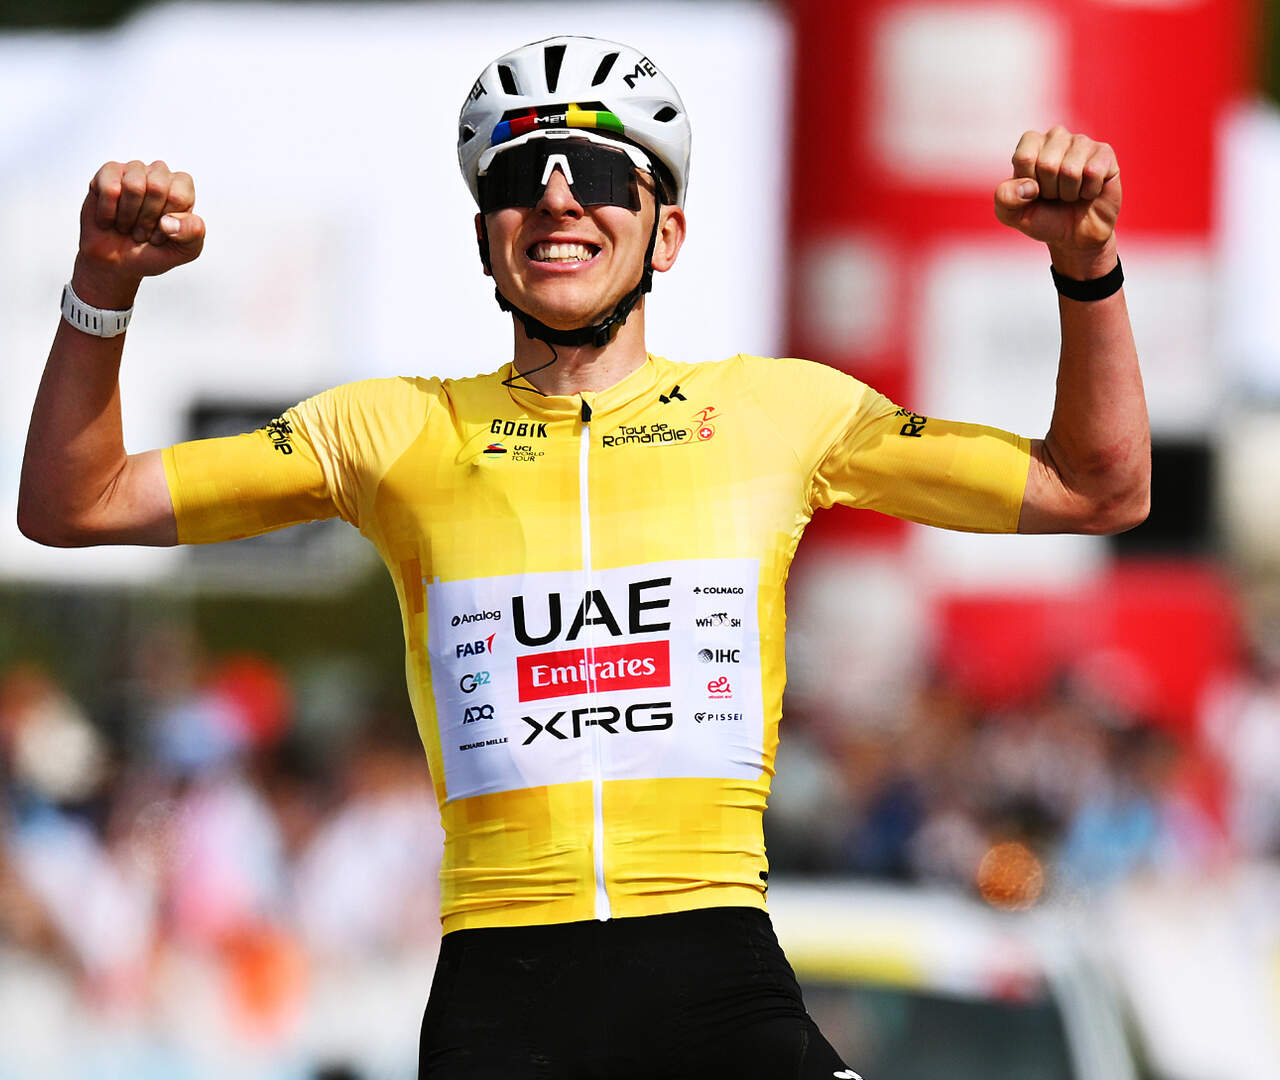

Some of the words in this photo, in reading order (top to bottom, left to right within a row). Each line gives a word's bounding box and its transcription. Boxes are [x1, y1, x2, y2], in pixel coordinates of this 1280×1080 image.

[490, 419, 549, 438] GOBIK
[619, 425, 647, 435] Tour
[650, 423, 668, 433] de
[602, 429, 687, 448] Romandie
[514, 444, 532, 452] UCI
[703, 586, 744, 595] COLNAGO
[461, 610, 501, 624] Analog
[511, 577, 672, 647] UAE
[715, 649, 741, 663] IHC
[531, 657, 656, 687] Emirates
[460, 671, 491, 693] G42
[521, 702, 673, 745] XRG
[707, 713, 743, 722] PISSEI
